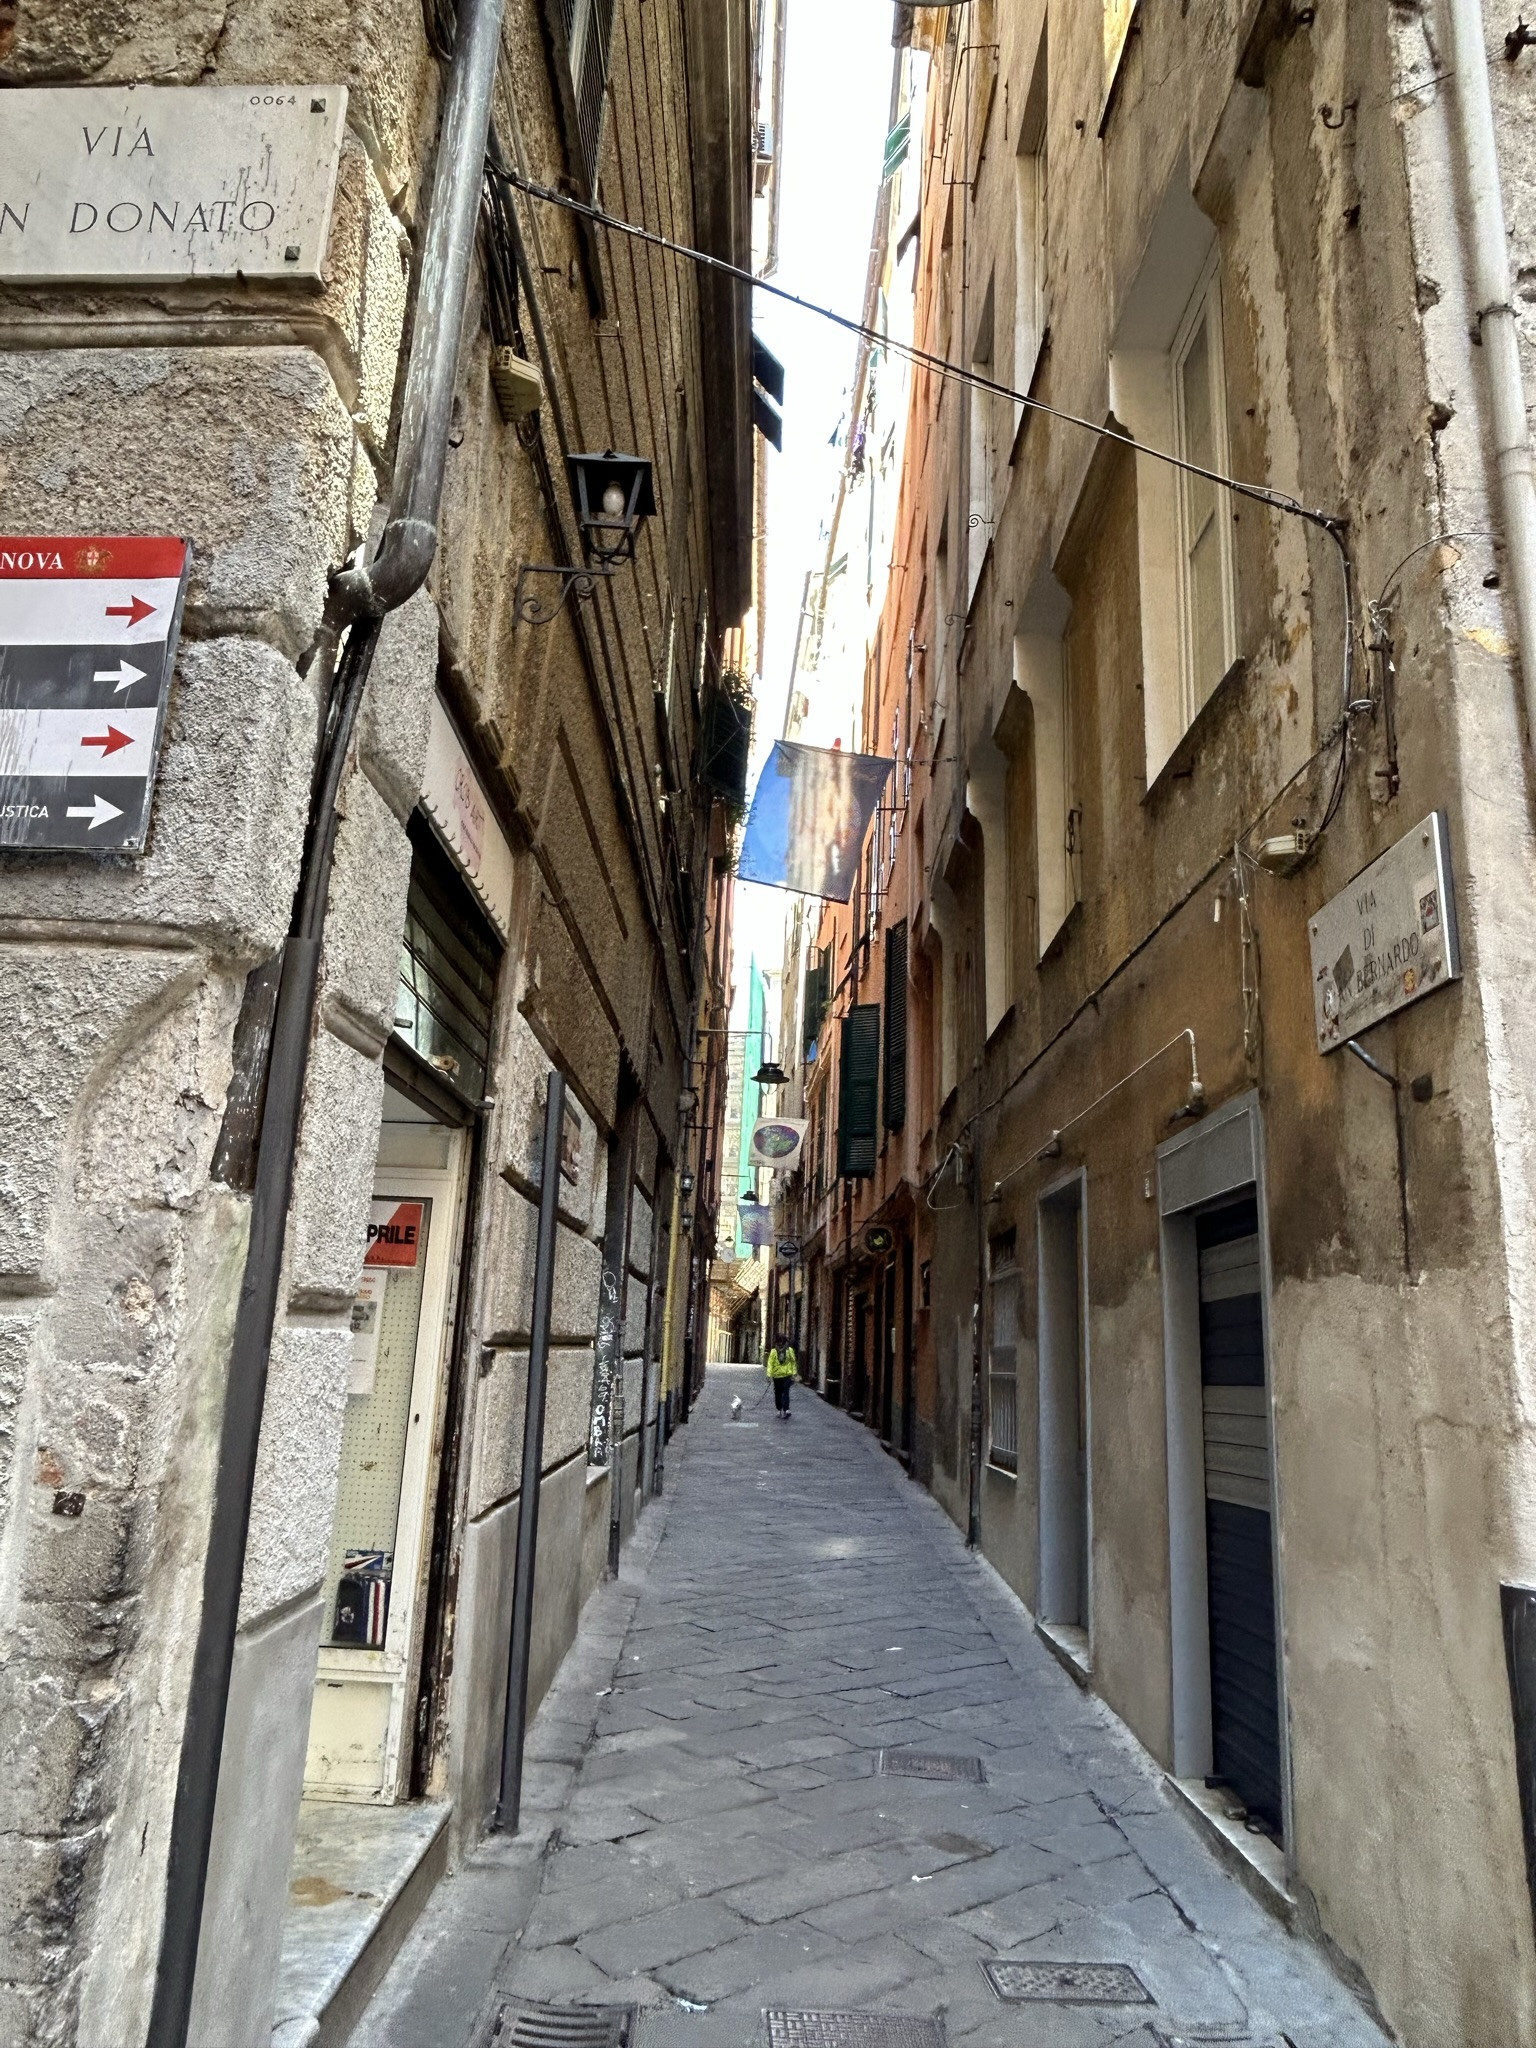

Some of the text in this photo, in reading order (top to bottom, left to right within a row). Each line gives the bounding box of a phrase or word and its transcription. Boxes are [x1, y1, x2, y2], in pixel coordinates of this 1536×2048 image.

[250, 95, 297, 106] 0064
[82, 126, 155, 156] VIA
[69, 201, 275, 233] DONATO
[0, 552, 65, 570] NOVA
[1356, 890, 1377, 915] VIA
[1363, 926, 1376, 951] DI
[1357, 932, 1420, 993] BERNARDO
